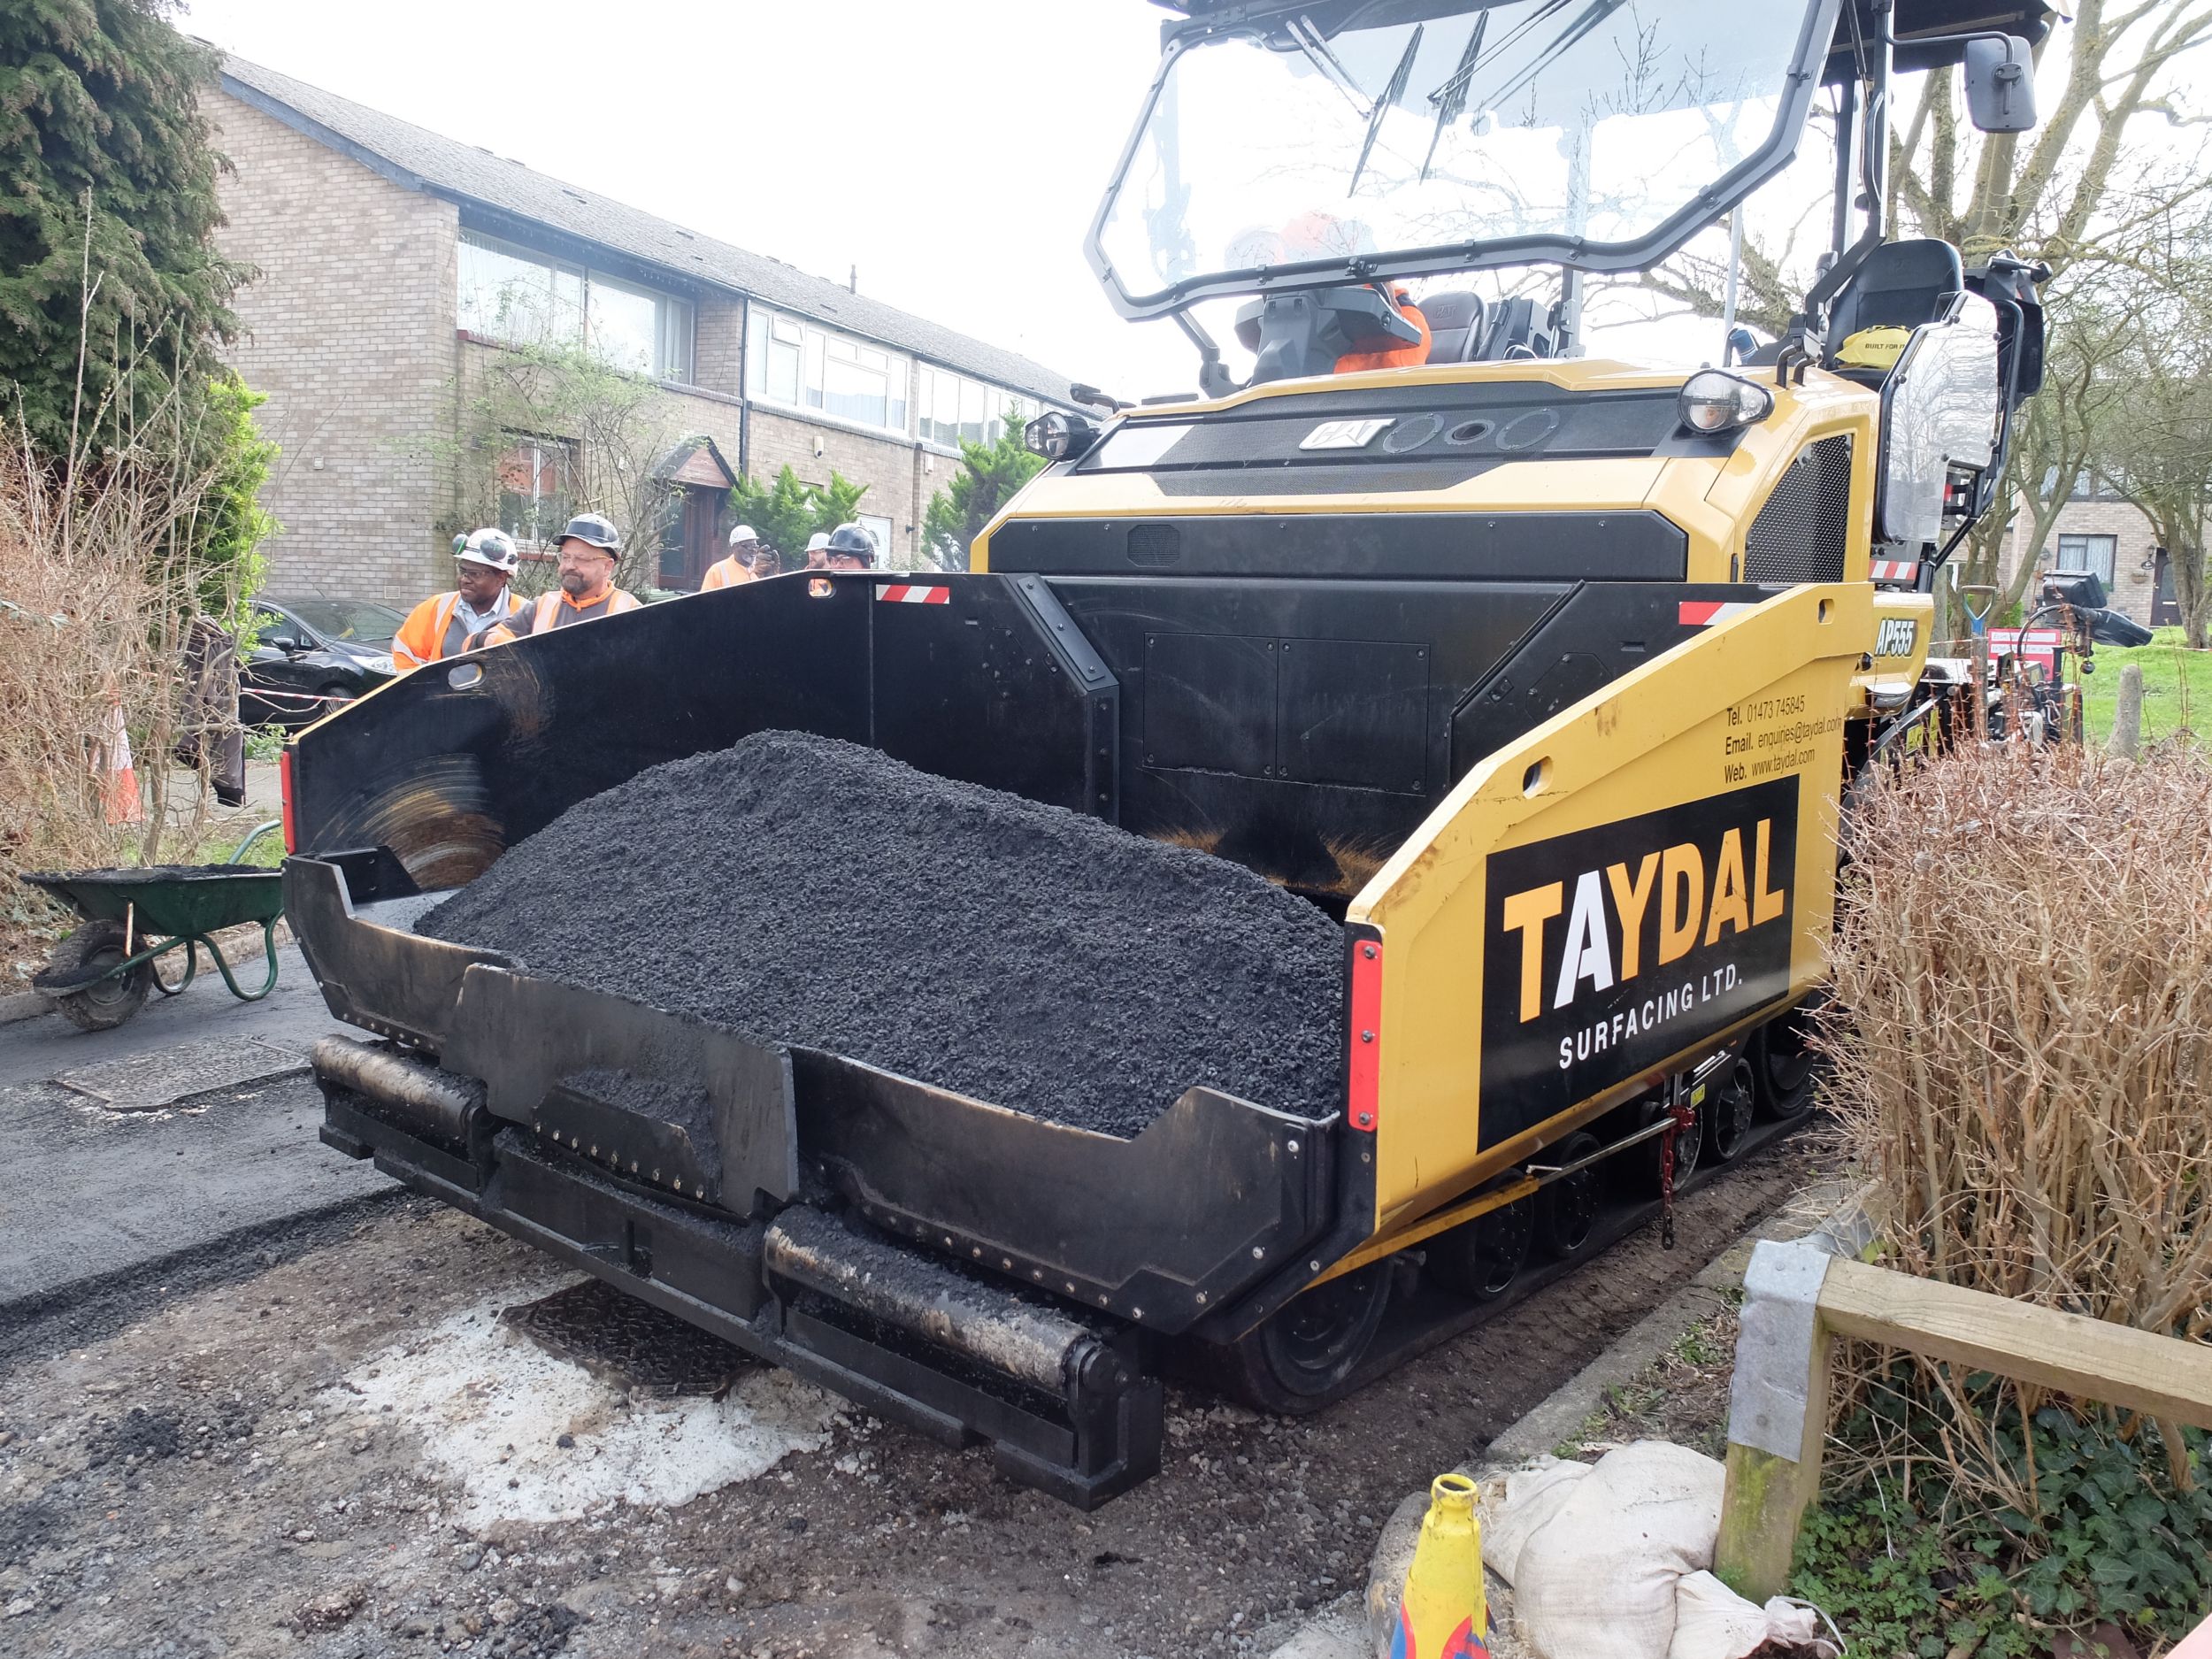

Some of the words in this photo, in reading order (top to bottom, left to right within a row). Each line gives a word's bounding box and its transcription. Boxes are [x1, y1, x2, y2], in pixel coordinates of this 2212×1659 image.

[1299, 418, 1396, 450] CAT
[1875, 618, 1915, 656] AP555
[1726, 707, 1743, 727] Tel.
[1747, 701, 1774, 723] 01473
[1776, 695, 1805, 717] 745845
[1725, 733, 1754, 755] Email.
[1758, 717, 1842, 749] enquiries@taydal.com
[1724, 764, 1747, 784] Web.
[1752, 748, 1815, 776] www.taydal.com
[1503, 818, 1785, 1024] TAYDAL
[1559, 982, 1694, 1070] SURFACING
[1701, 963, 1743, 1002] LTD.
